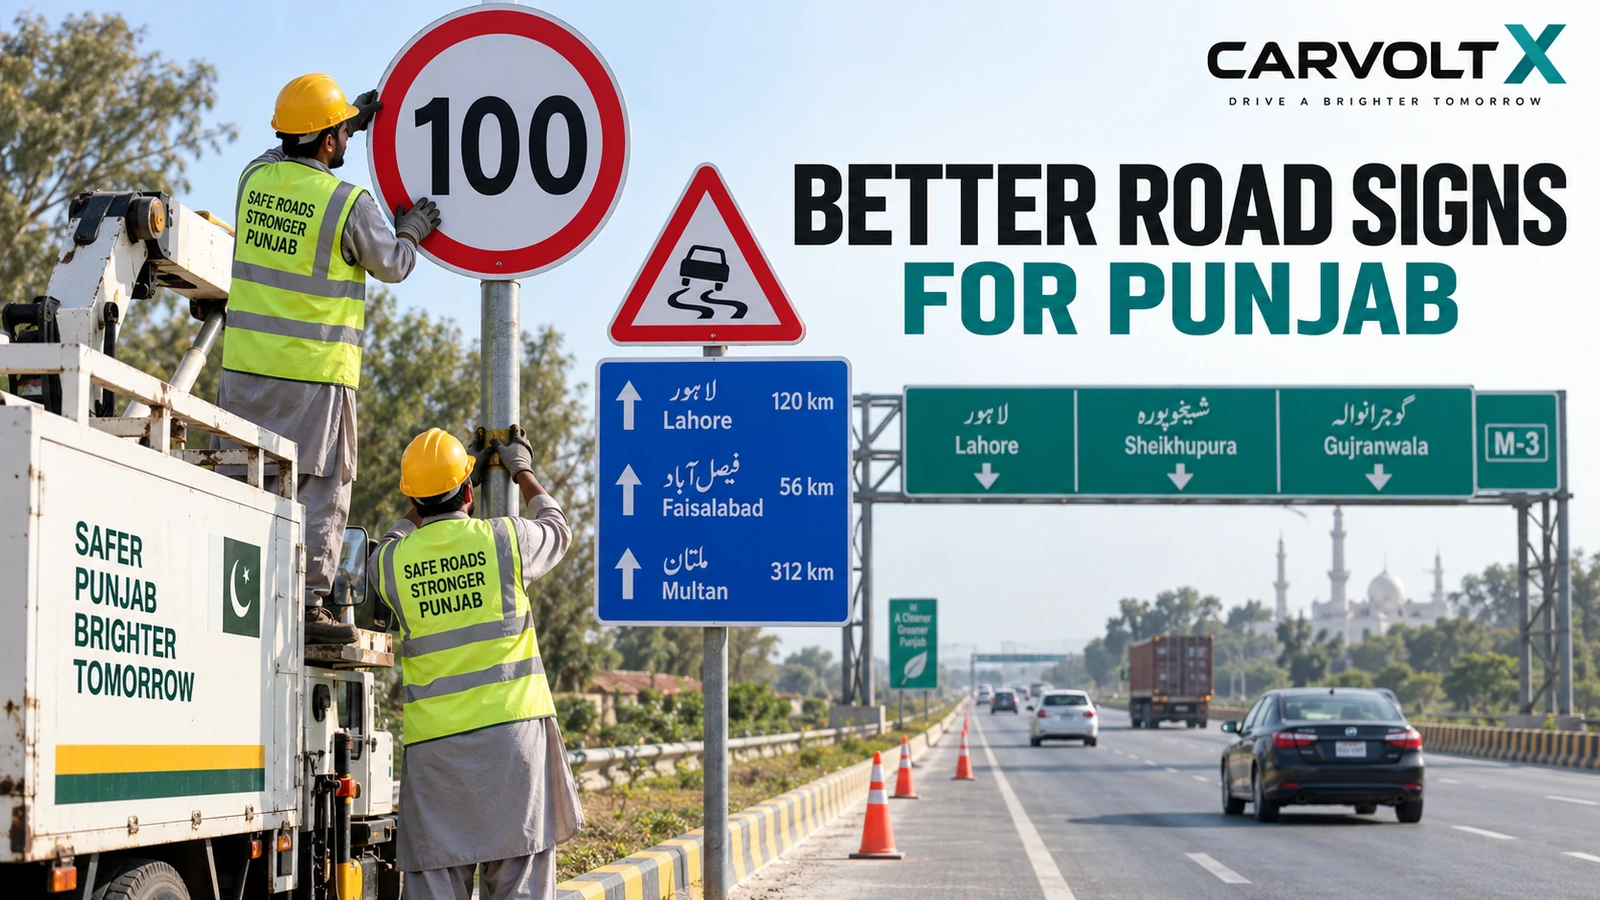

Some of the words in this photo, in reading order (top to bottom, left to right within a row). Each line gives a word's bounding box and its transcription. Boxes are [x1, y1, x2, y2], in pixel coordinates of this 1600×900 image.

[414, 95, 588, 195] 100
[247, 190, 275, 209] SAFE
[275, 197, 315, 218] ROADS
[246, 209, 307, 237] STRONGER
[245, 229, 298, 255] PUNJAB
[669, 379, 717, 401] لاہور
[772, 392, 803, 410] 120
[807, 392, 834, 410] km
[663, 410, 733, 430] Lahore
[963, 402, 1009, 425] لاہور
[955, 435, 1019, 455] Lahore
[1125, 435, 1237, 459] Sheikhupura
[1324, 435, 1428, 459] Gujranwala
[1494, 431, 1540, 455] M-3
[779, 477, 802, 496] 56
[807, 477, 834, 496] km
[663, 498, 764, 517] Faisalabad
[75, 521, 142, 568] SAFER
[404, 560, 437, 579] SAFE
[440, 551, 486, 573] ROADS
[663, 546, 708, 575] ملتان
[771, 562, 802, 581] 312
[807, 562, 834, 581] km
[75, 566, 157, 613] PUNJAB
[411, 571, 486, 598] STRONGER
[662, 581, 728, 600] Multan
[419, 592, 483, 618] PUNJAB
[895, 612, 901, 623] A
[75, 612, 176, 659] BRIGHTER
[900, 637, 927, 649] Punjab
[73, 658, 195, 702] TOMORROW
